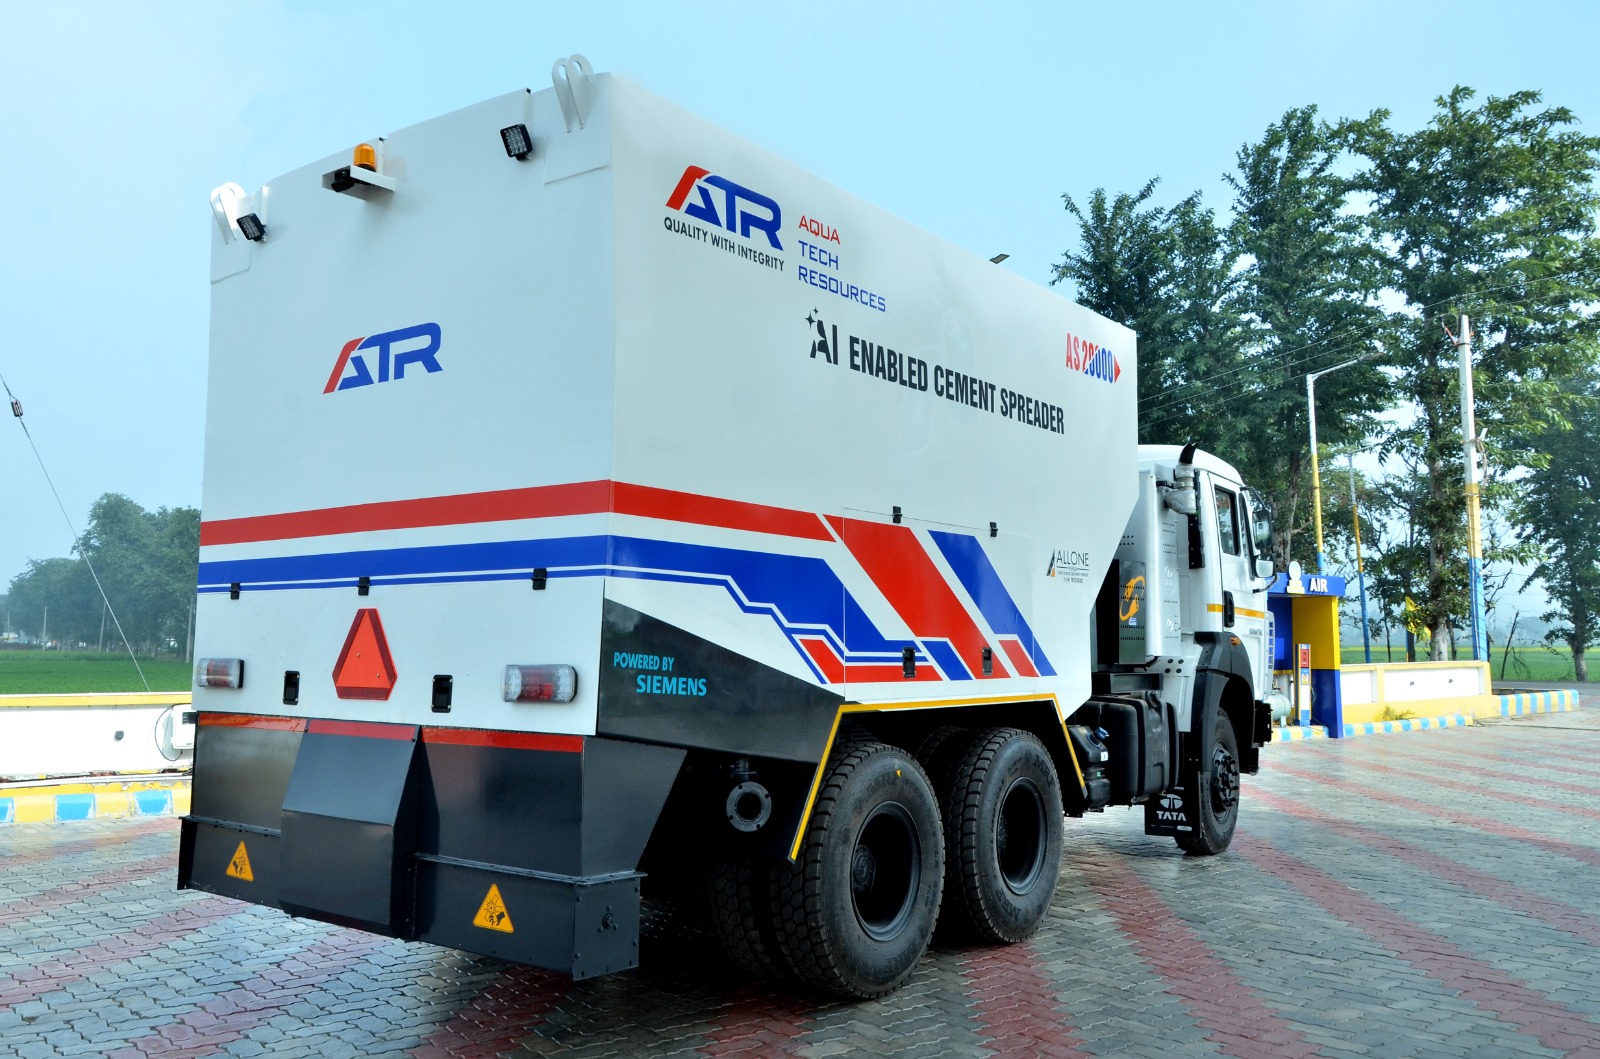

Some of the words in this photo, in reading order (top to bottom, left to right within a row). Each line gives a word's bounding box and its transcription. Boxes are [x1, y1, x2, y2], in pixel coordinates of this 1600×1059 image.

[666, 165, 784, 251] ATR
[664, 216, 708, 243] QUALITY
[710, 232, 735, 254] WITH
[737, 244, 785, 272] INTEGRITY
[798, 215, 841, 245] AQUA
[798, 240, 839, 270] TECH
[798, 265, 886, 312] RESOURCES
[322, 322, 443, 394] ATR
[810, 319, 839, 366] AI
[849, 335, 928, 392] ENABLED
[934, 364, 996, 413] CEMENT
[1000, 388, 1065, 435] SPREADER
[1056, 550, 1089, 567] ALLONE
[1309, 577, 1328, 593] AIR
[613, 651, 660, 670] POWERED
[661, 656, 674, 671] BY
[636, 674, 707, 696] SIEMENS
[1032, 754, 1056, 788] MRF
[1156, 810, 1187, 821] TATA
